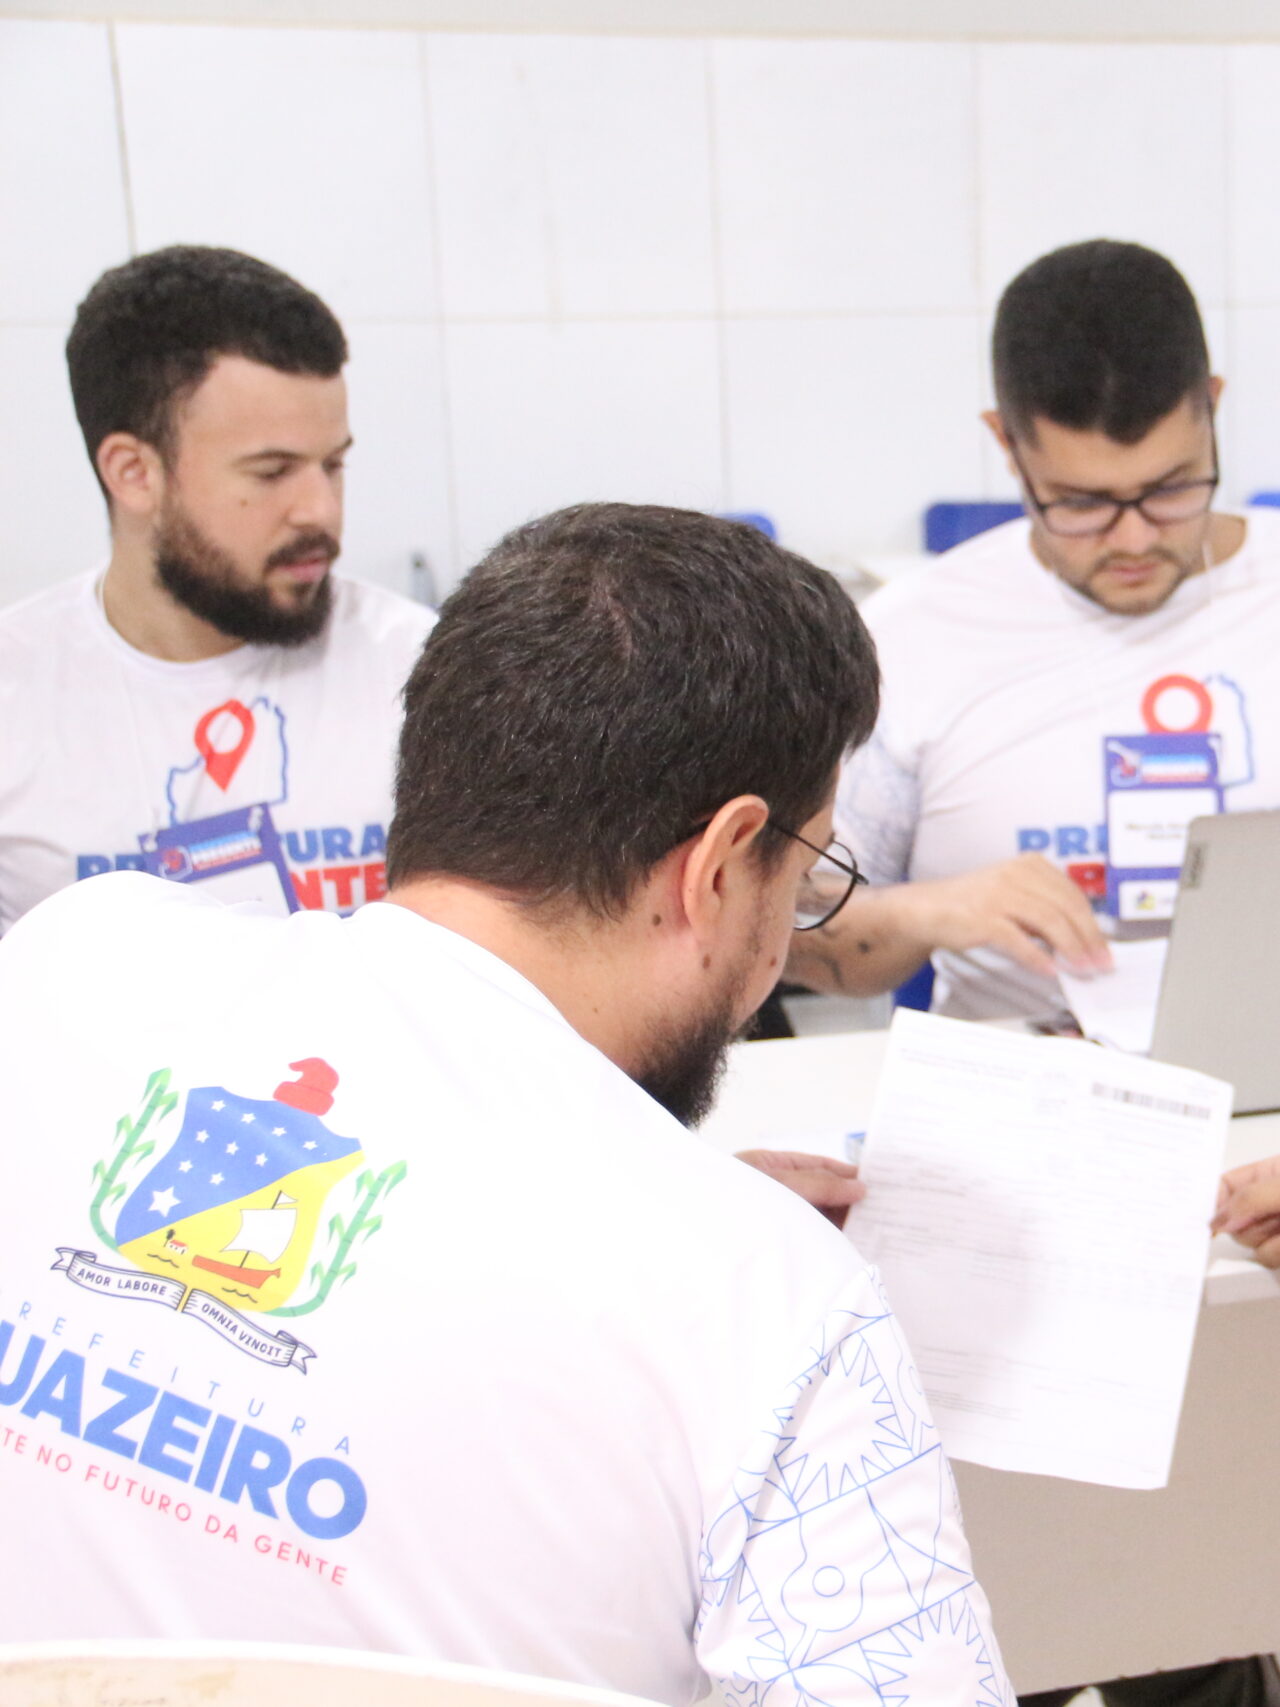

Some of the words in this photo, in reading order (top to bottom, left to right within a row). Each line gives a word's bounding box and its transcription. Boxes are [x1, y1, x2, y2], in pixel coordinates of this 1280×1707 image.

[18, 1301, 350, 1455] REFEITURA
[77, 1267, 111, 1287] AMOR
[117, 1278, 168, 1296] LABORE
[200, 1303, 239, 1335] OMNIA
[239, 1331, 283, 1358] VINCIT
[0, 1319, 368, 1541] UAZEIRO
[0, 1426, 28, 1455] TE
[36, 1444, 72, 1473] NO
[84, 1464, 192, 1522] FUTURO
[204, 1514, 239, 1544] DA
[254, 1534, 349, 1586] GENTE
